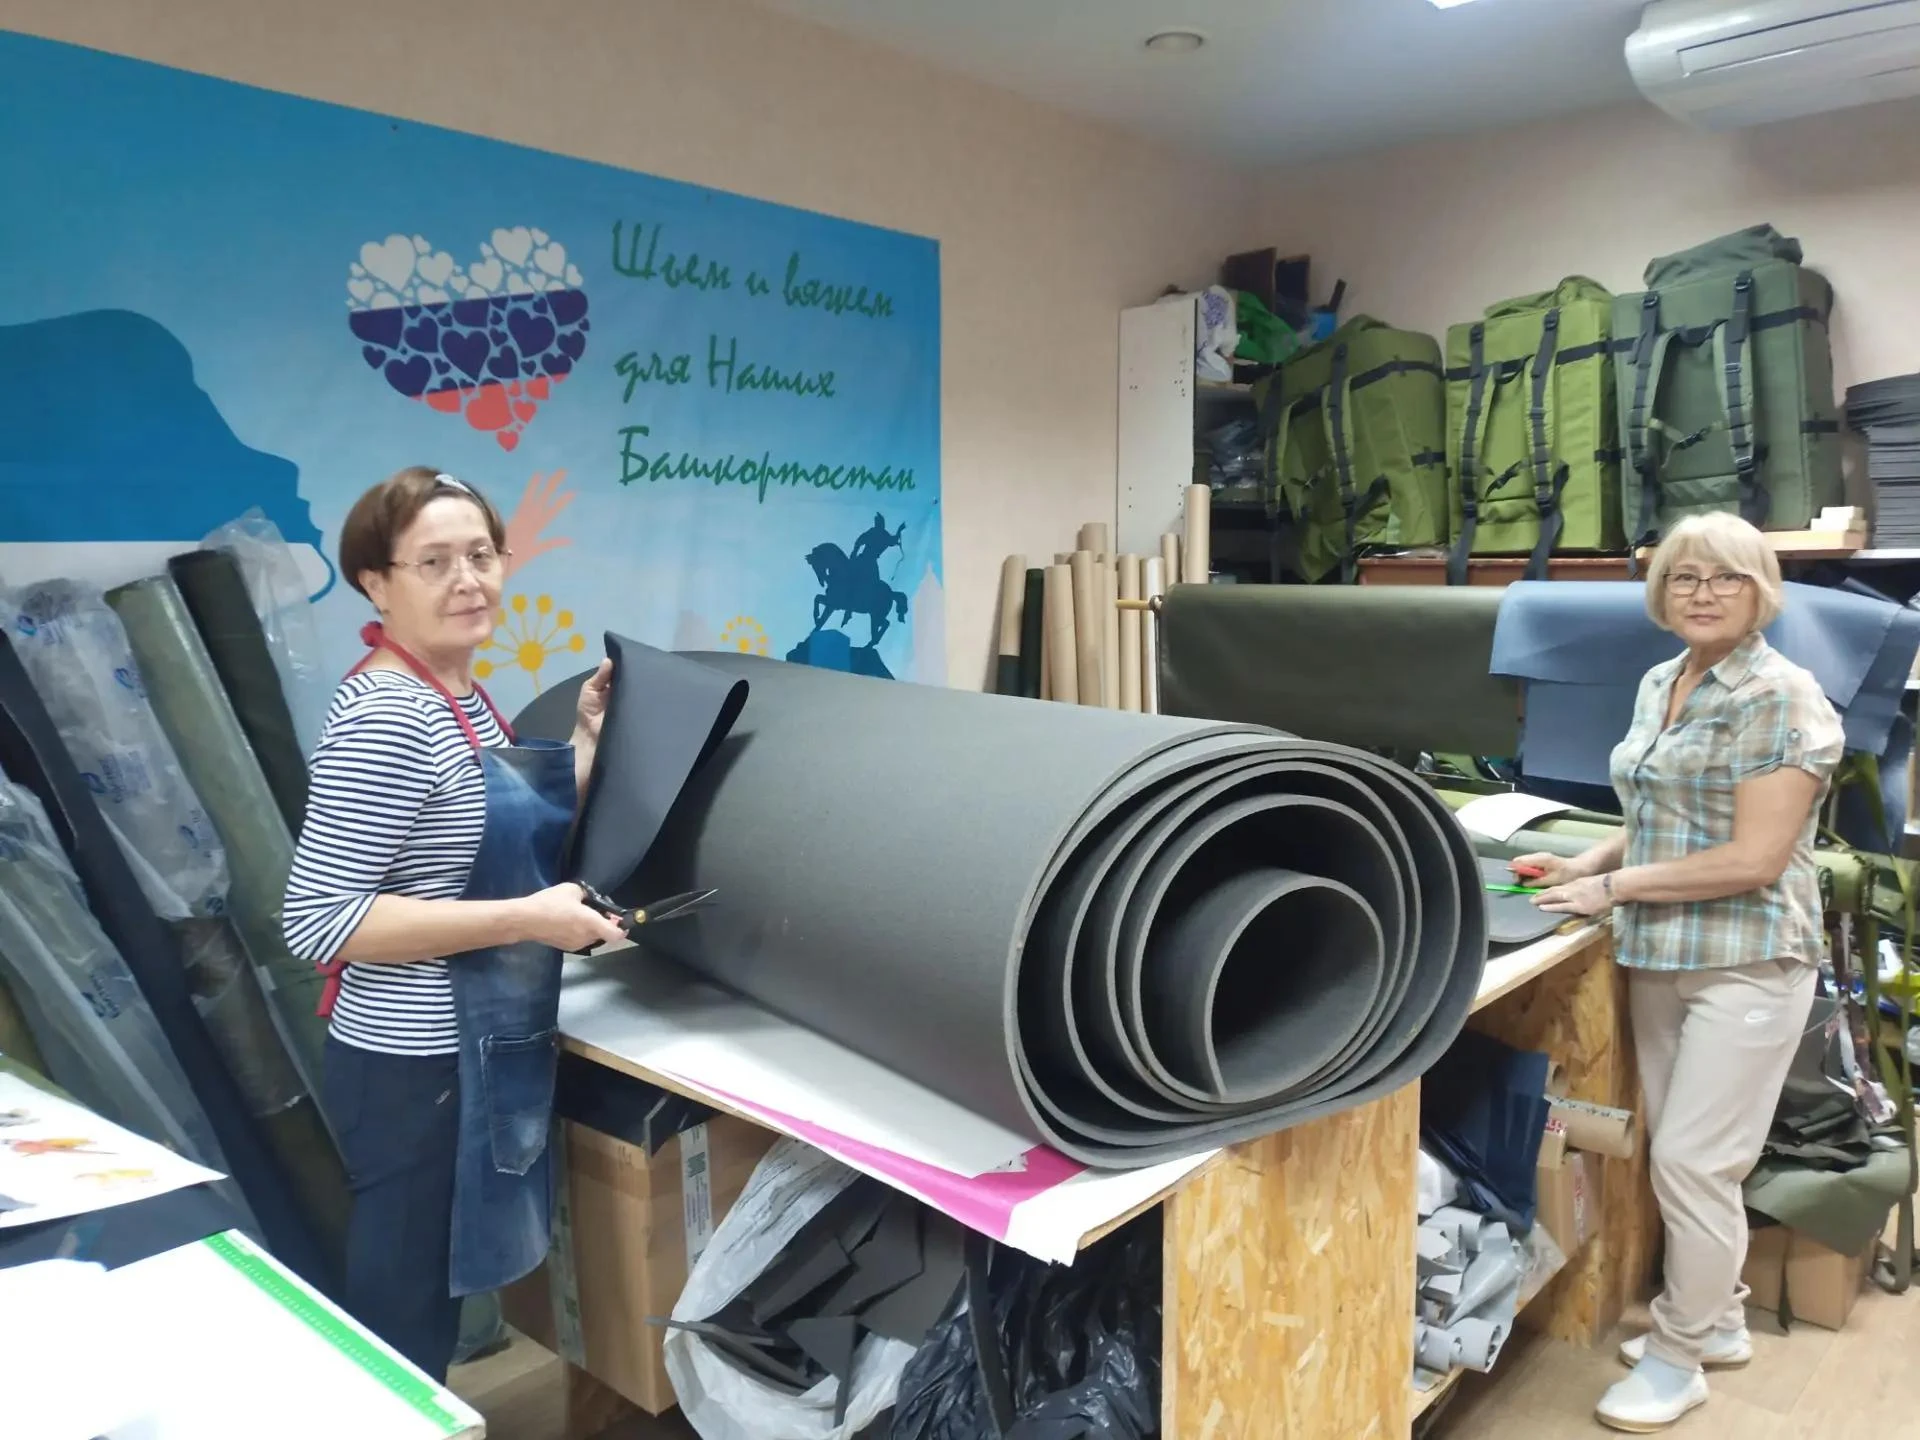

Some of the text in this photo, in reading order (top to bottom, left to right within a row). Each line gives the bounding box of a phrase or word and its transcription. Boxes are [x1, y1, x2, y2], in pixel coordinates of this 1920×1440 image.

[611, 218, 894, 318] Шьем и вяжем
[613, 333, 836, 404] для Наших
[617, 424, 916, 505] Башкортостан
